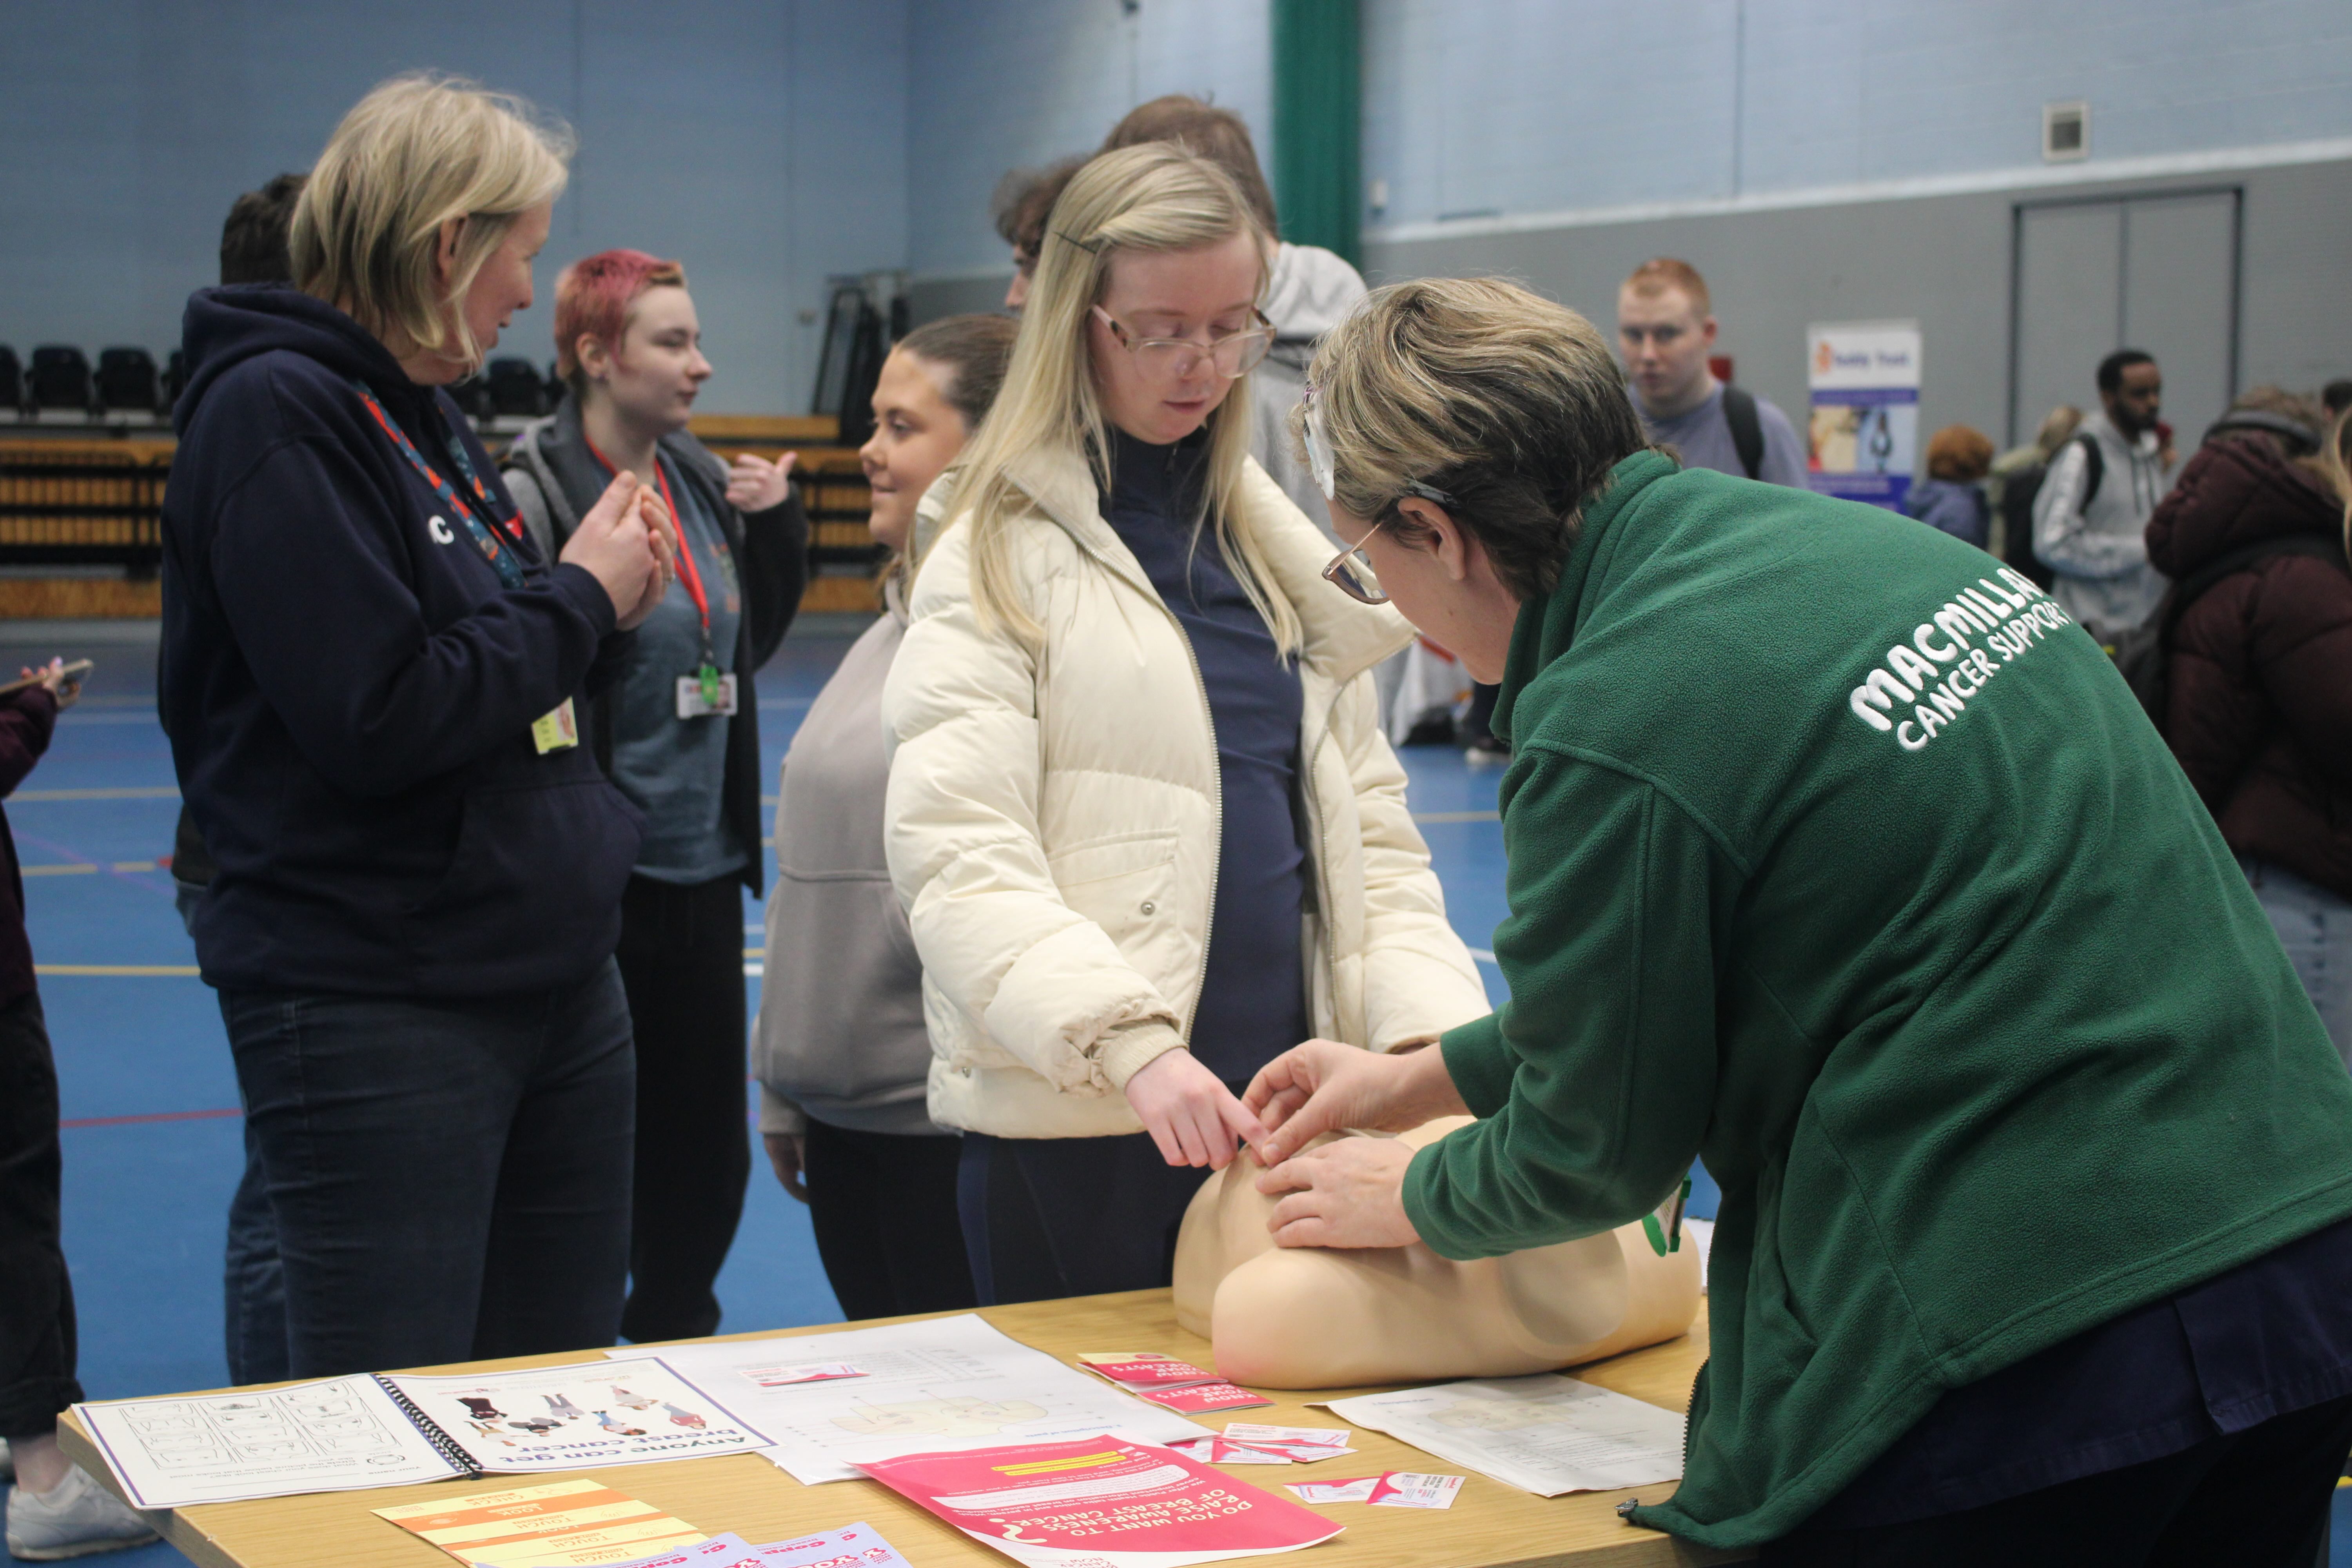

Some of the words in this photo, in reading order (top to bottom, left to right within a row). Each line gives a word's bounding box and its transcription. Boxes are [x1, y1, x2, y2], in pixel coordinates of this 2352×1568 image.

[1897, 648, 2000, 751] CANCER
[1156, 1384, 1236, 1399] BREASTS
[1196, 1388, 1248, 1397] YOUR
[1203, 1393, 1258, 1403] KNOW
[633, 1429, 738, 1443] breast
[519, 1440, 626, 1453] cancer
[630, 1437, 746, 1453] Anyone
[499, 1454, 556, 1463] get
[564, 1450, 622, 1459] can
[1176, 1477, 1200, 1487] cover
[1130, 1485, 1175, 1495] important
[1198, 1489, 1226, 1502] OF
[467, 1495, 524, 1506] CHECK
[1107, 1494, 1138, 1502] Health
[1112, 1498, 1194, 1515] BREAST
[1175, 1495, 1240, 1514] RAISE
[1222, 1500, 1253, 1514] DO
[497, 1506, 543, 1516] LOOK
[1177, 1511, 1221, 1523] YOU
[516, 1518, 576, 1529] TOUCH
[1011, 1510, 1104, 1526] CANCER
[1042, 1510, 1171, 1531] AWARENESS
[1110, 1518, 1172, 1531] WANT
[1070, 1527, 1104, 1536] TO
[552, 1536, 612, 1548] TOUCH
[786, 1538, 819, 1546] breast
[573, 1551, 635, 1563] TOUCH
[647, 1554, 681, 1563] breast
